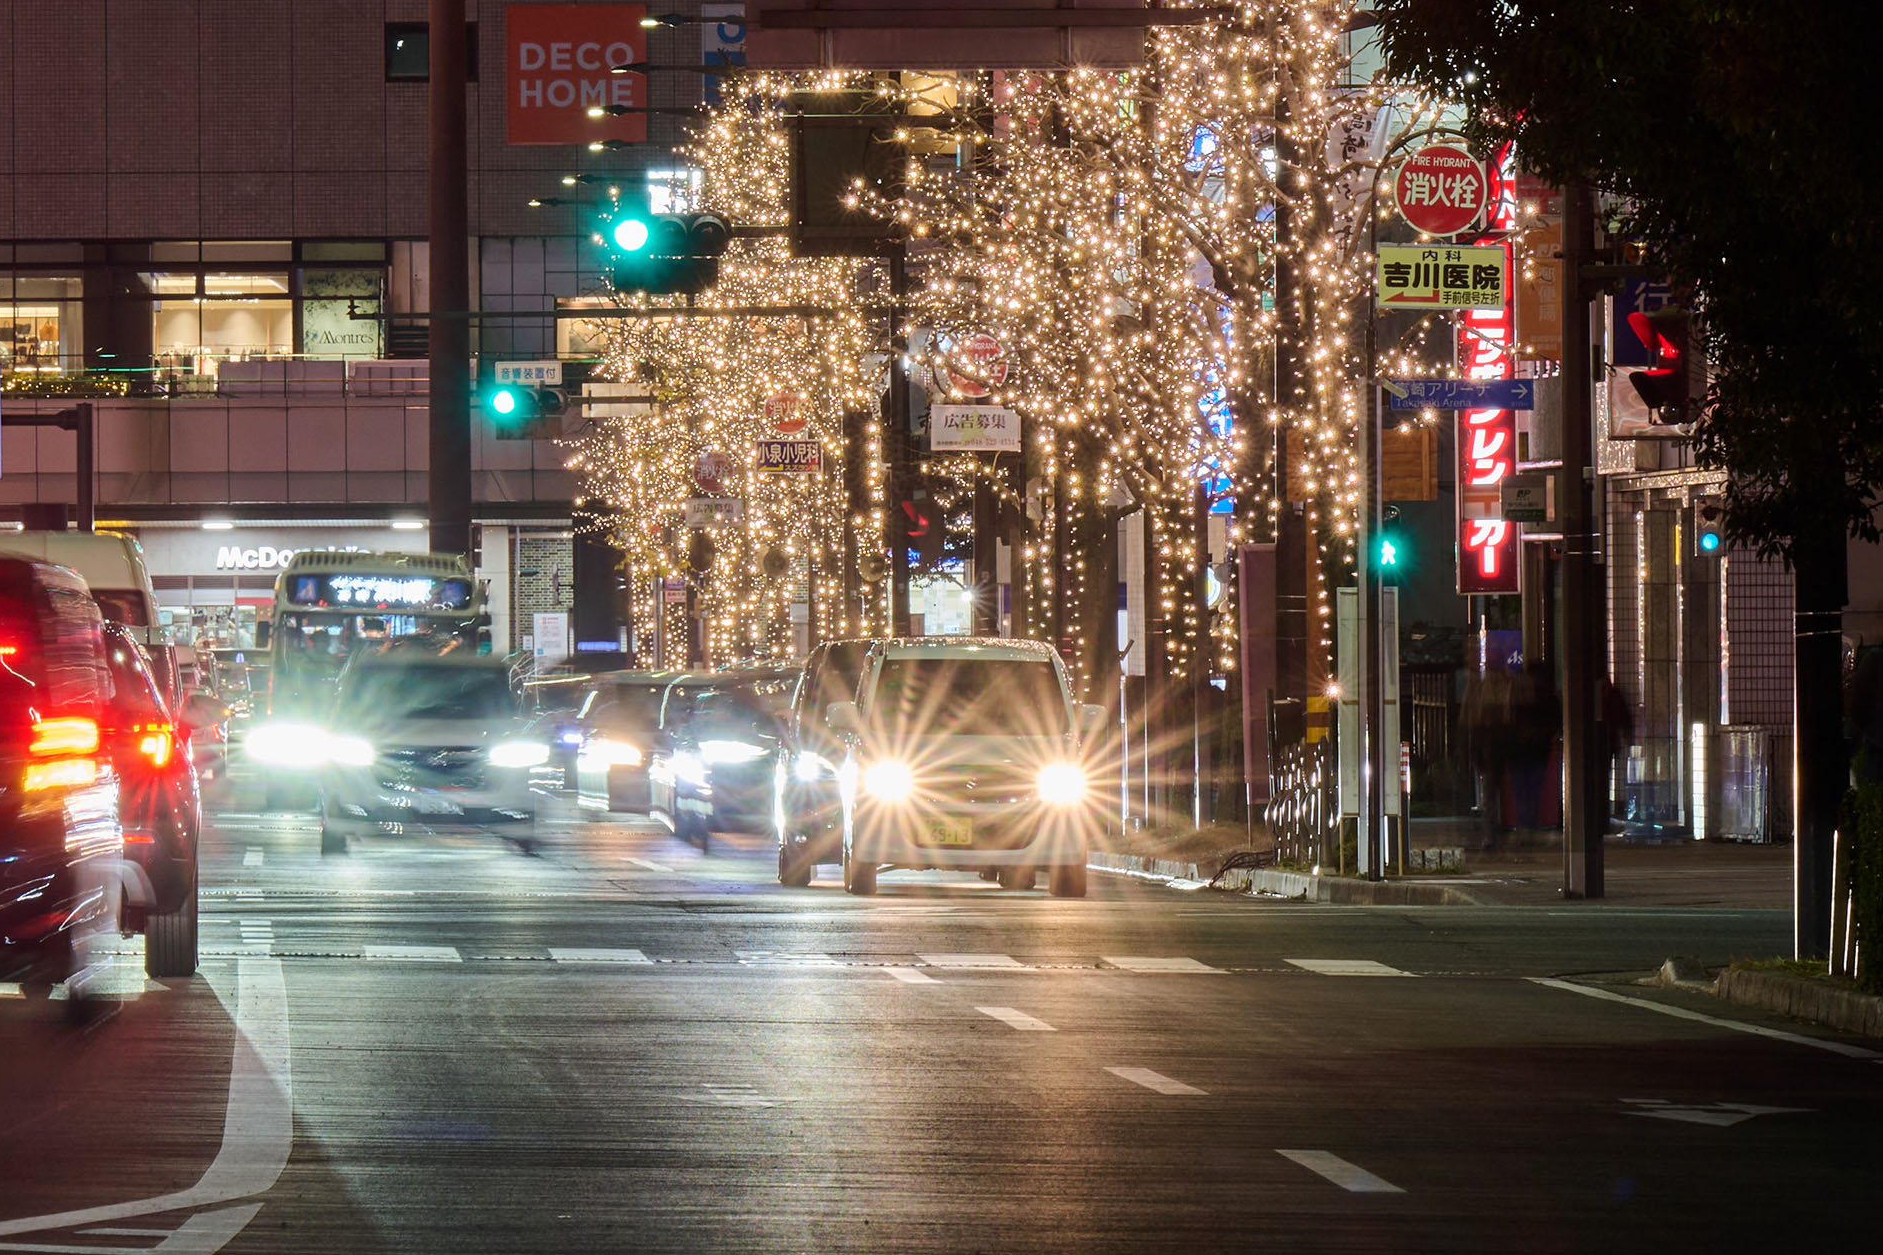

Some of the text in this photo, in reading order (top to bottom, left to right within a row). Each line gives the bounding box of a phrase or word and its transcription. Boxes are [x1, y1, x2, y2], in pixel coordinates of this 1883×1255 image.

[519, 42, 634, 71] DECO
[519, 78, 634, 107] HOME
[1412, 156, 1471, 168] FIRE HYDRANT
[1404, 172, 1478, 209] 消火栓
[1422, 250, 1462, 262] 内科
[1383, 262, 1500, 290] 吉川医院
[1443, 291, 1500, 304] 手前信号左折
[319, 330, 374, 345] Montres
[1443, 398, 1472, 408] Arena
[944, 412, 1006, 429] 広告募集
[759, 443, 820, 464] 小泉小児科
